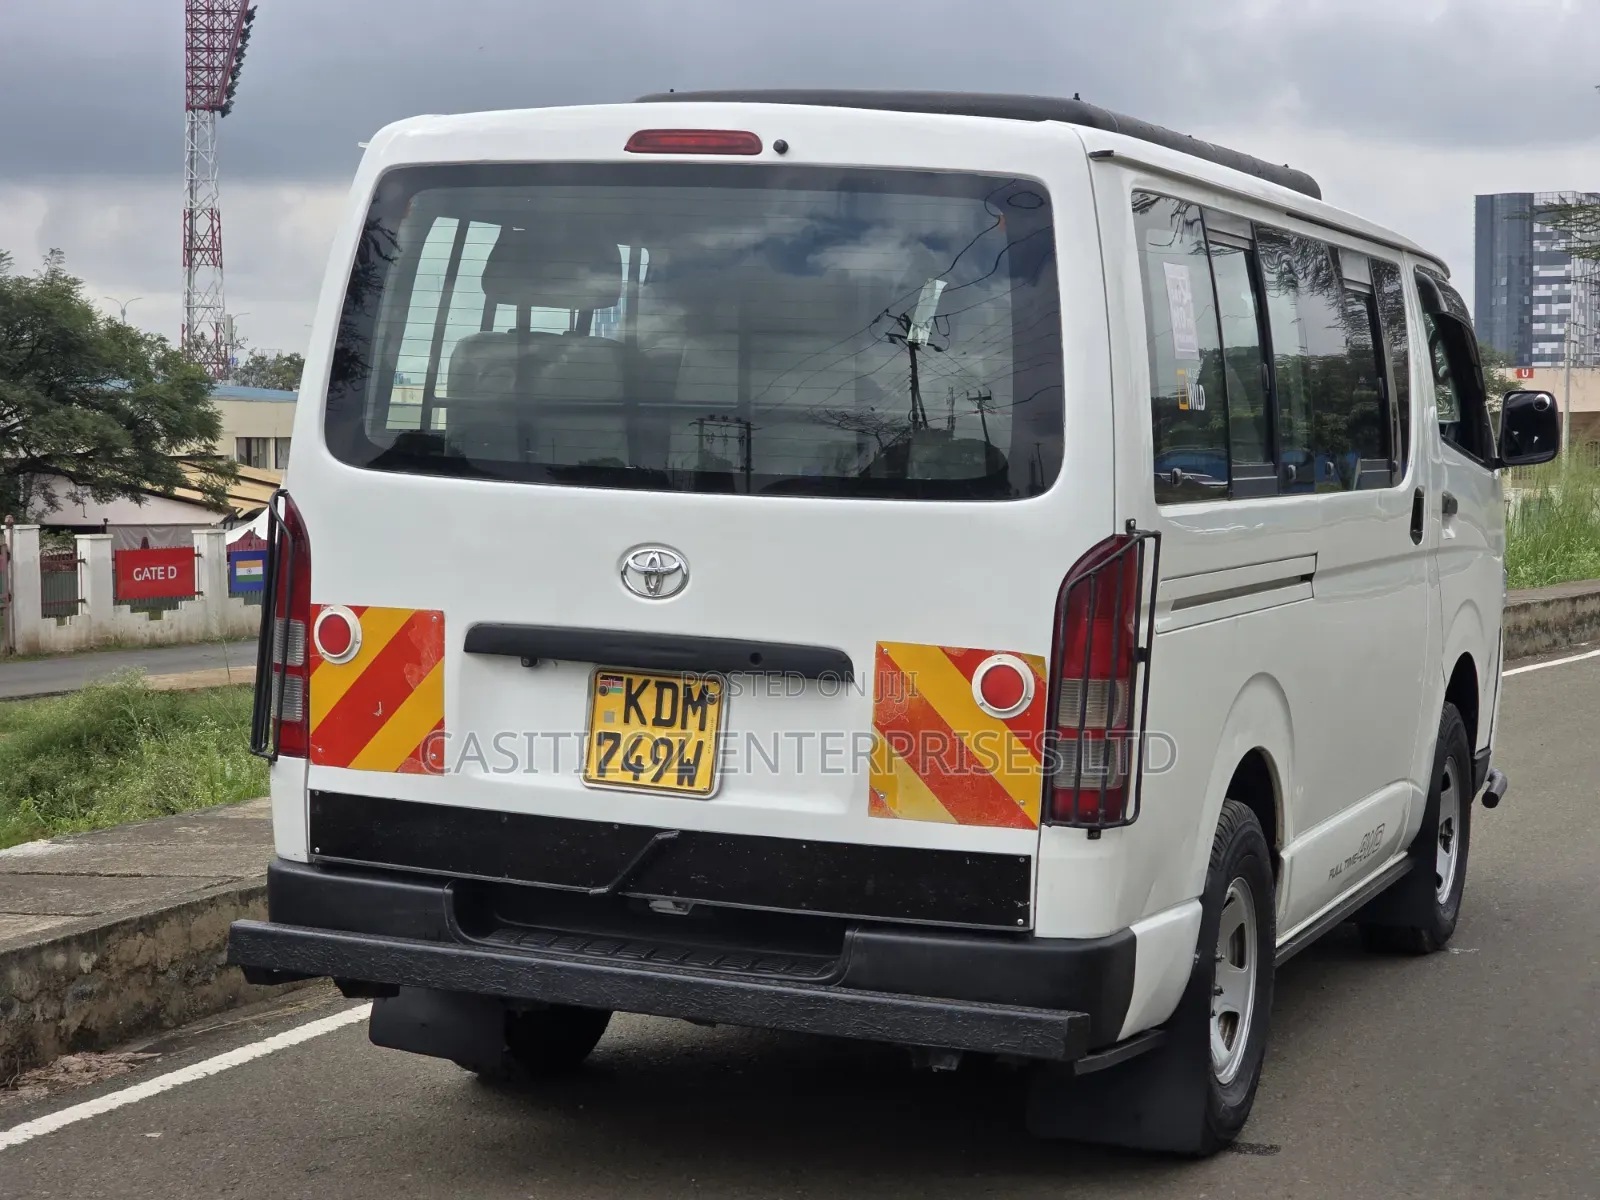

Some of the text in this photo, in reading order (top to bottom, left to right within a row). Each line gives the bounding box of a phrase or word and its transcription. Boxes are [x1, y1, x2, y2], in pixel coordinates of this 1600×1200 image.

[1186, 382, 1206, 411] WILD
[133, 566, 177, 581] GATE D
[623, 677, 708, 731] KDM
[596, 731, 704, 787] 749W
[1327, 862, 1343, 880] FULL
